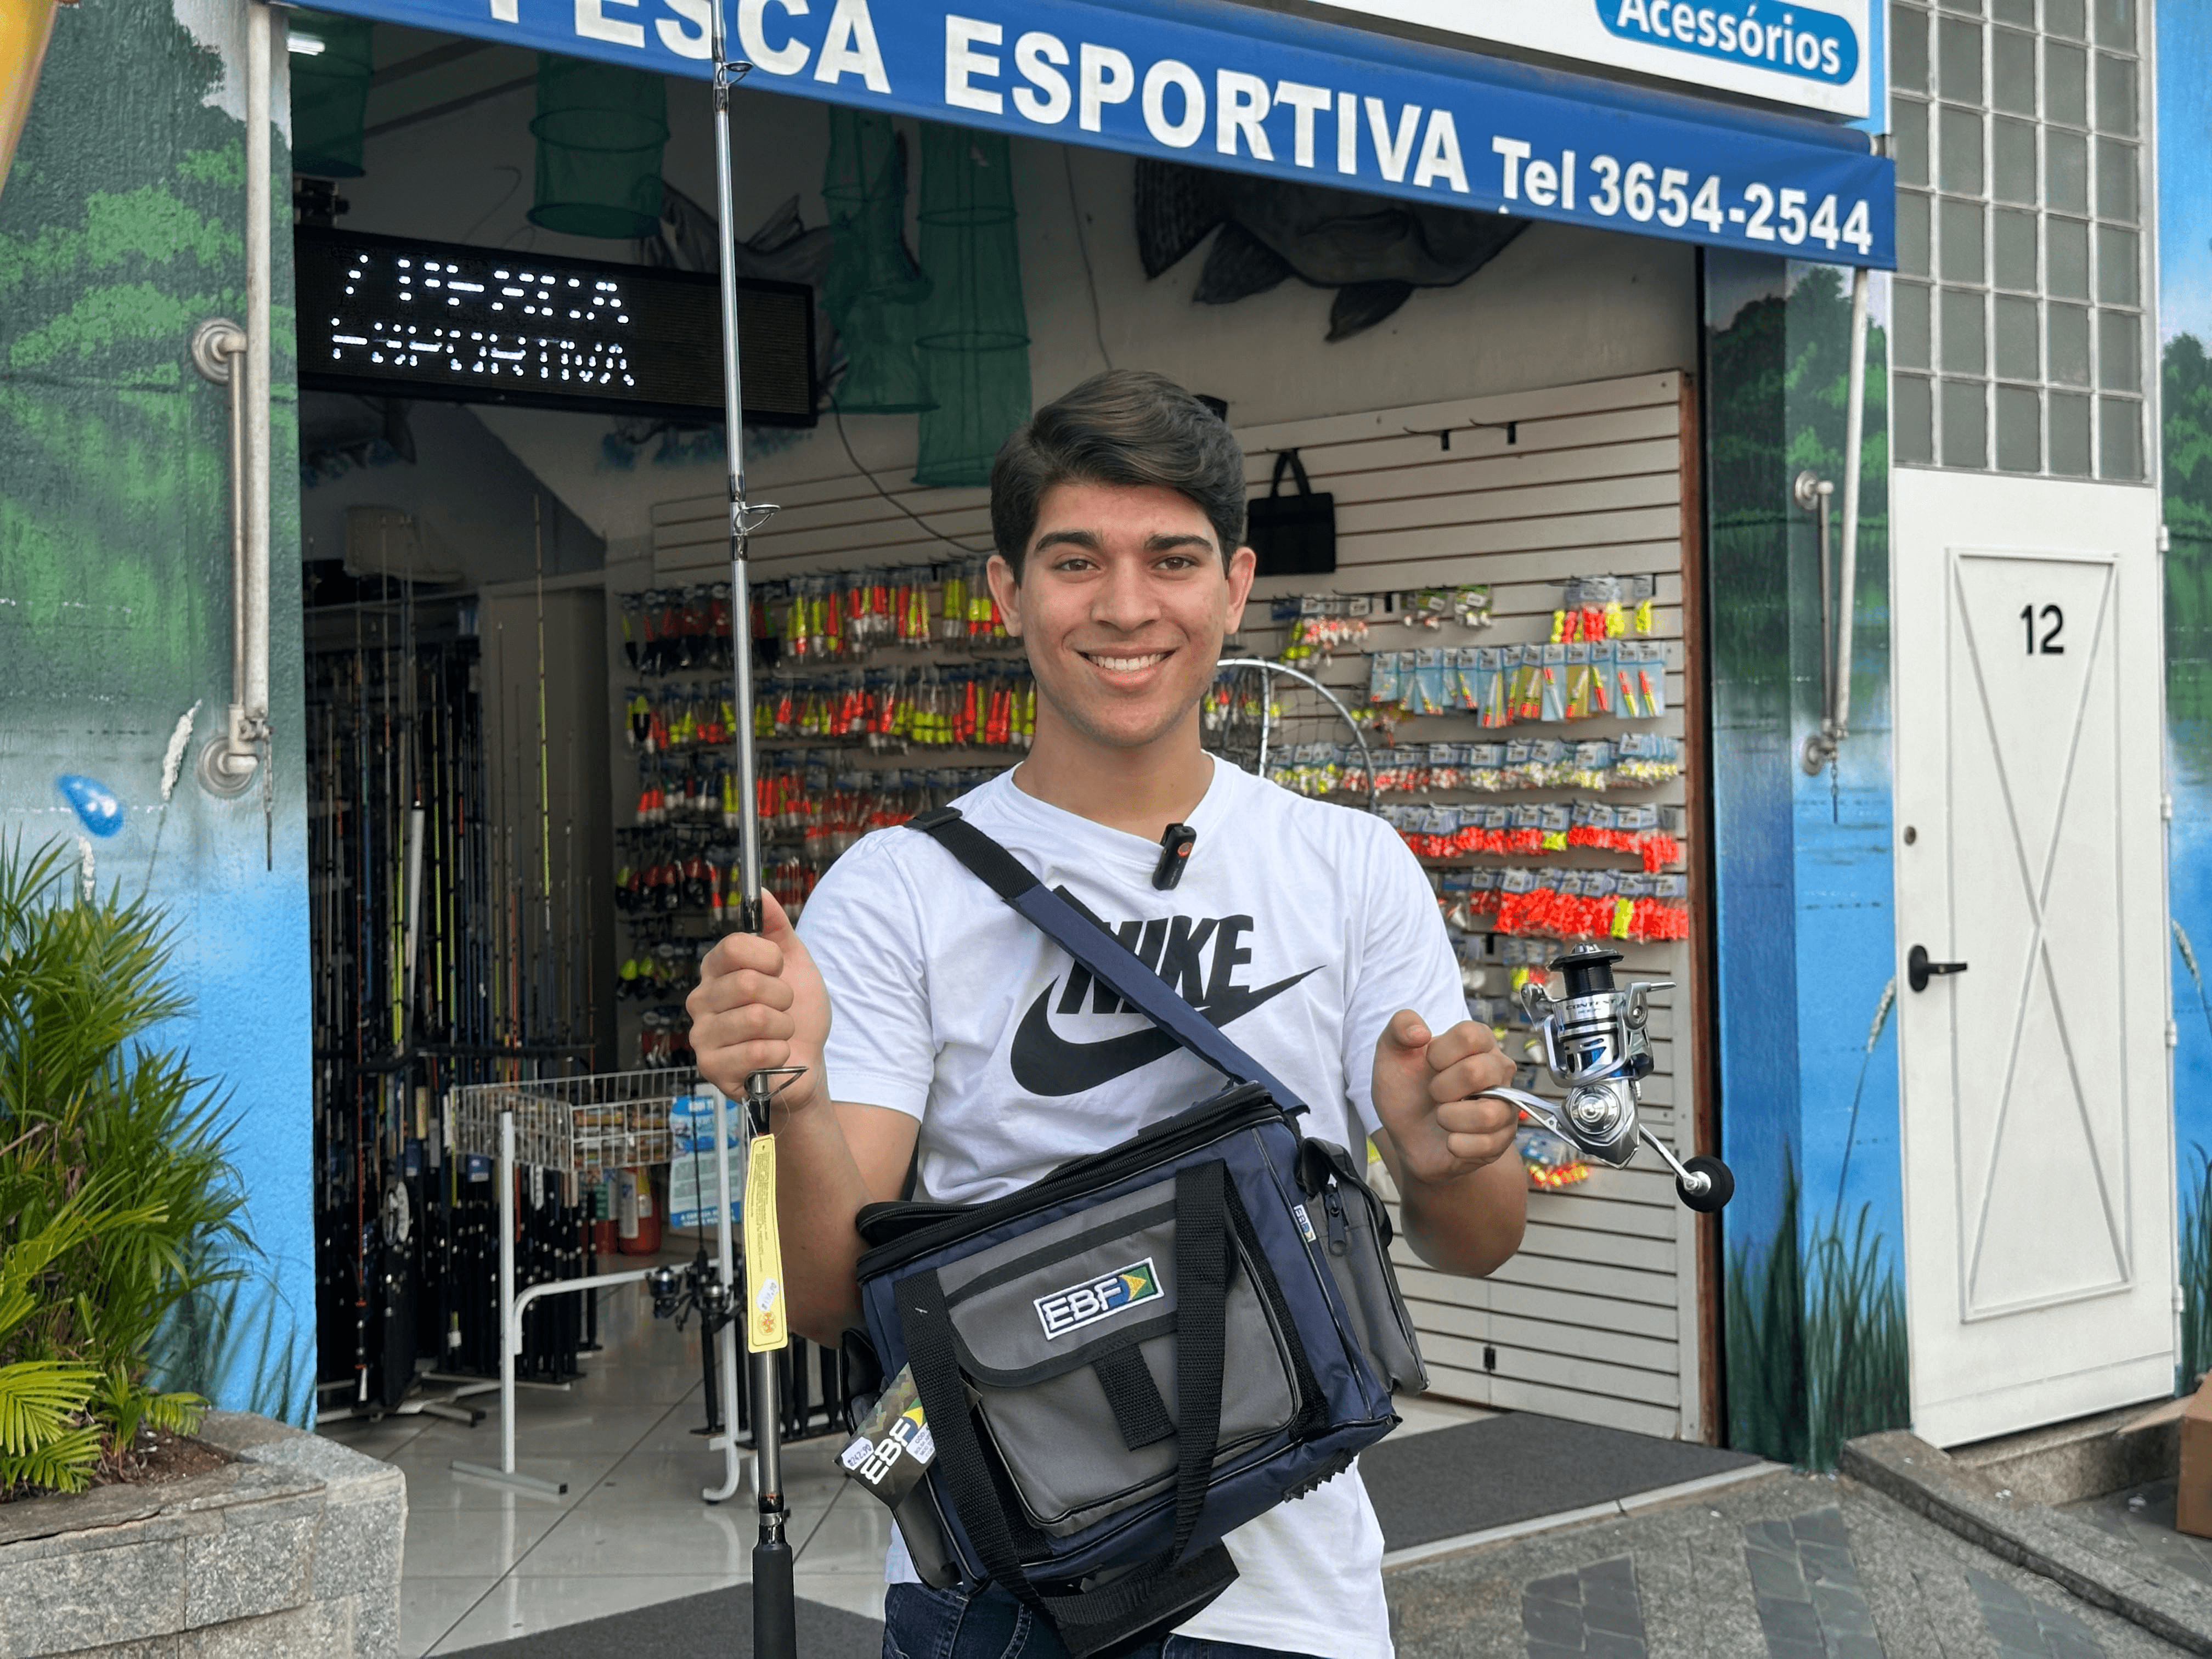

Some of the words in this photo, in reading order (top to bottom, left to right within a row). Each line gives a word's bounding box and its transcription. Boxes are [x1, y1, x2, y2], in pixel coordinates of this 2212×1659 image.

[1616, 0, 1841, 75] Acessórios
[945, 14, 1470, 194] ESPORTIVA
[1492, 136, 1576, 210] Tel
[1589, 154, 1873, 255] 3654-2544
[2019, 604, 2064, 655] 12
[1053, 900, 1254, 1014] NIKE
[1042, 1278, 1121, 1330] EBF
[860, 1418, 911, 1485] EBF
